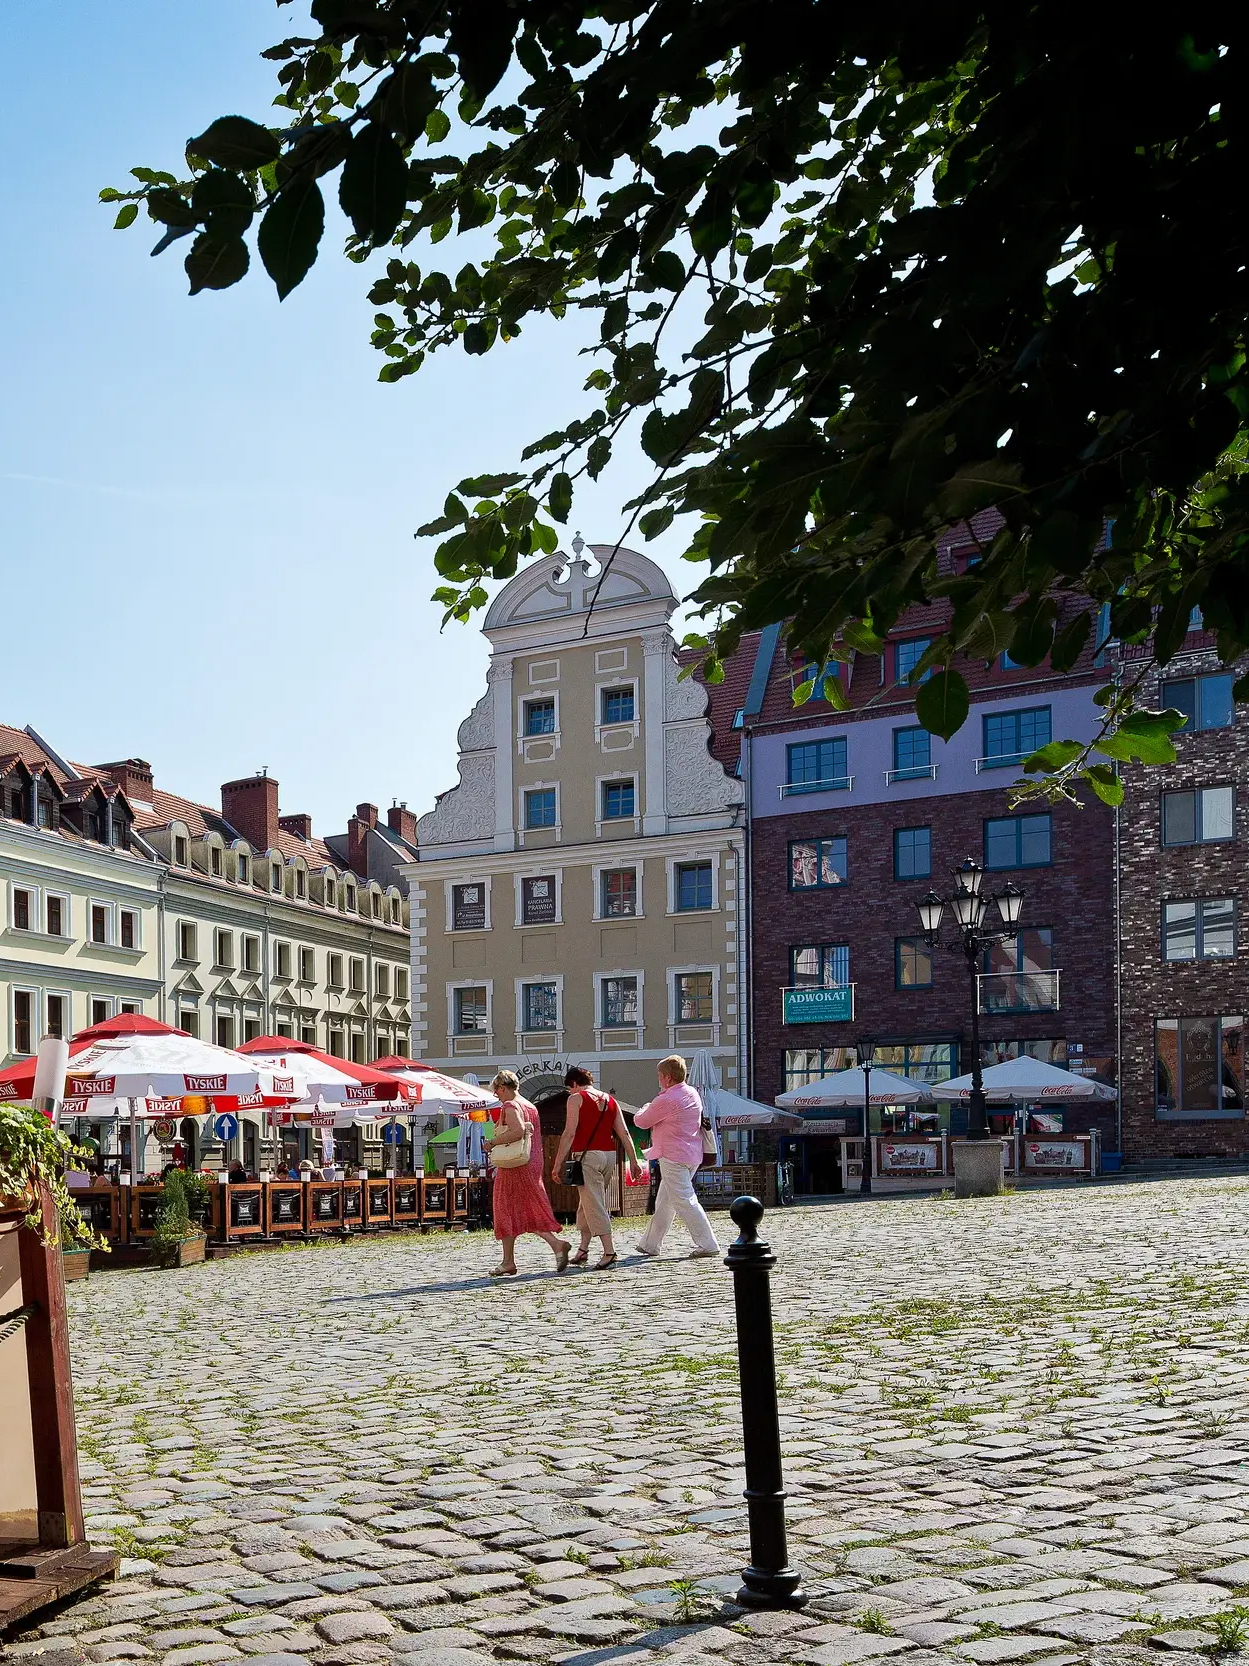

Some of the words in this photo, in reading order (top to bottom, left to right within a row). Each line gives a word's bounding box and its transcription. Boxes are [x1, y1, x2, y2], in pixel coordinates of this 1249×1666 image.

[788, 992, 847, 1004] ADWOKAT
[73, 1079, 113, 1093] TYSKIE
[187, 1074, 225, 1090] TYSKIE
[274, 1078, 294, 1091] TYSKIE
[347, 1086, 376, 1098] TYSKIE
